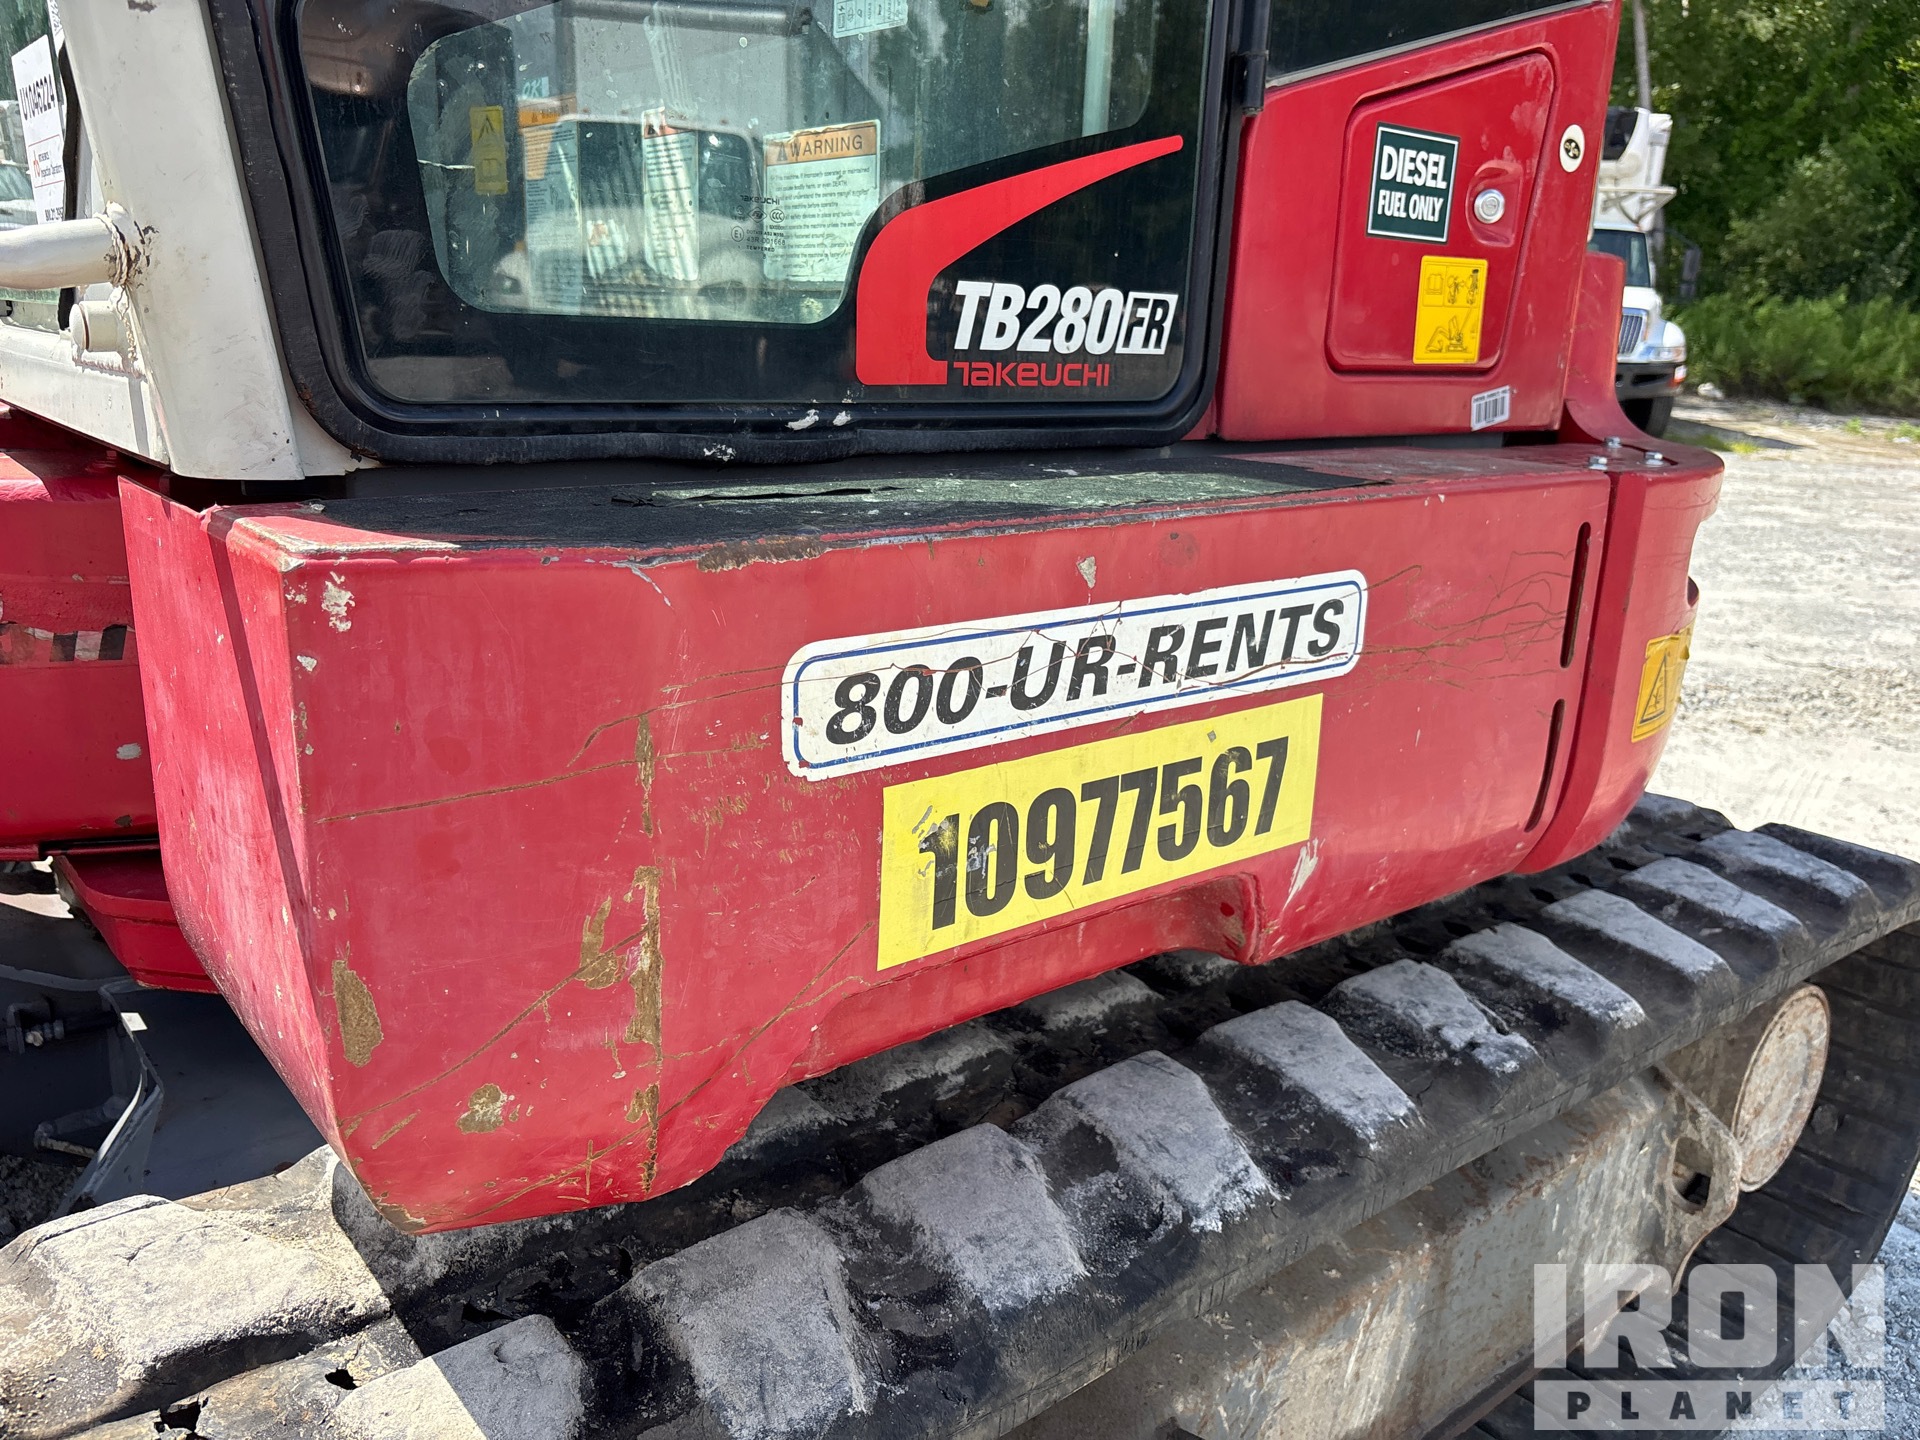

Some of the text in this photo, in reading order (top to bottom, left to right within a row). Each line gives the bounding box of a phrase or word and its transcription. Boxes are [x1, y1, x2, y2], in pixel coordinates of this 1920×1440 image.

[790, 135, 863, 157] WARNING
[1380, 145, 1447, 189] DIESEL
[1377, 189, 1444, 222] FUEL ONLY
[746, 244, 776, 253] TEMPERED
[825, 598, 1346, 746] 800-UR-RENTS
[919, 736, 1289, 931] 10977567
